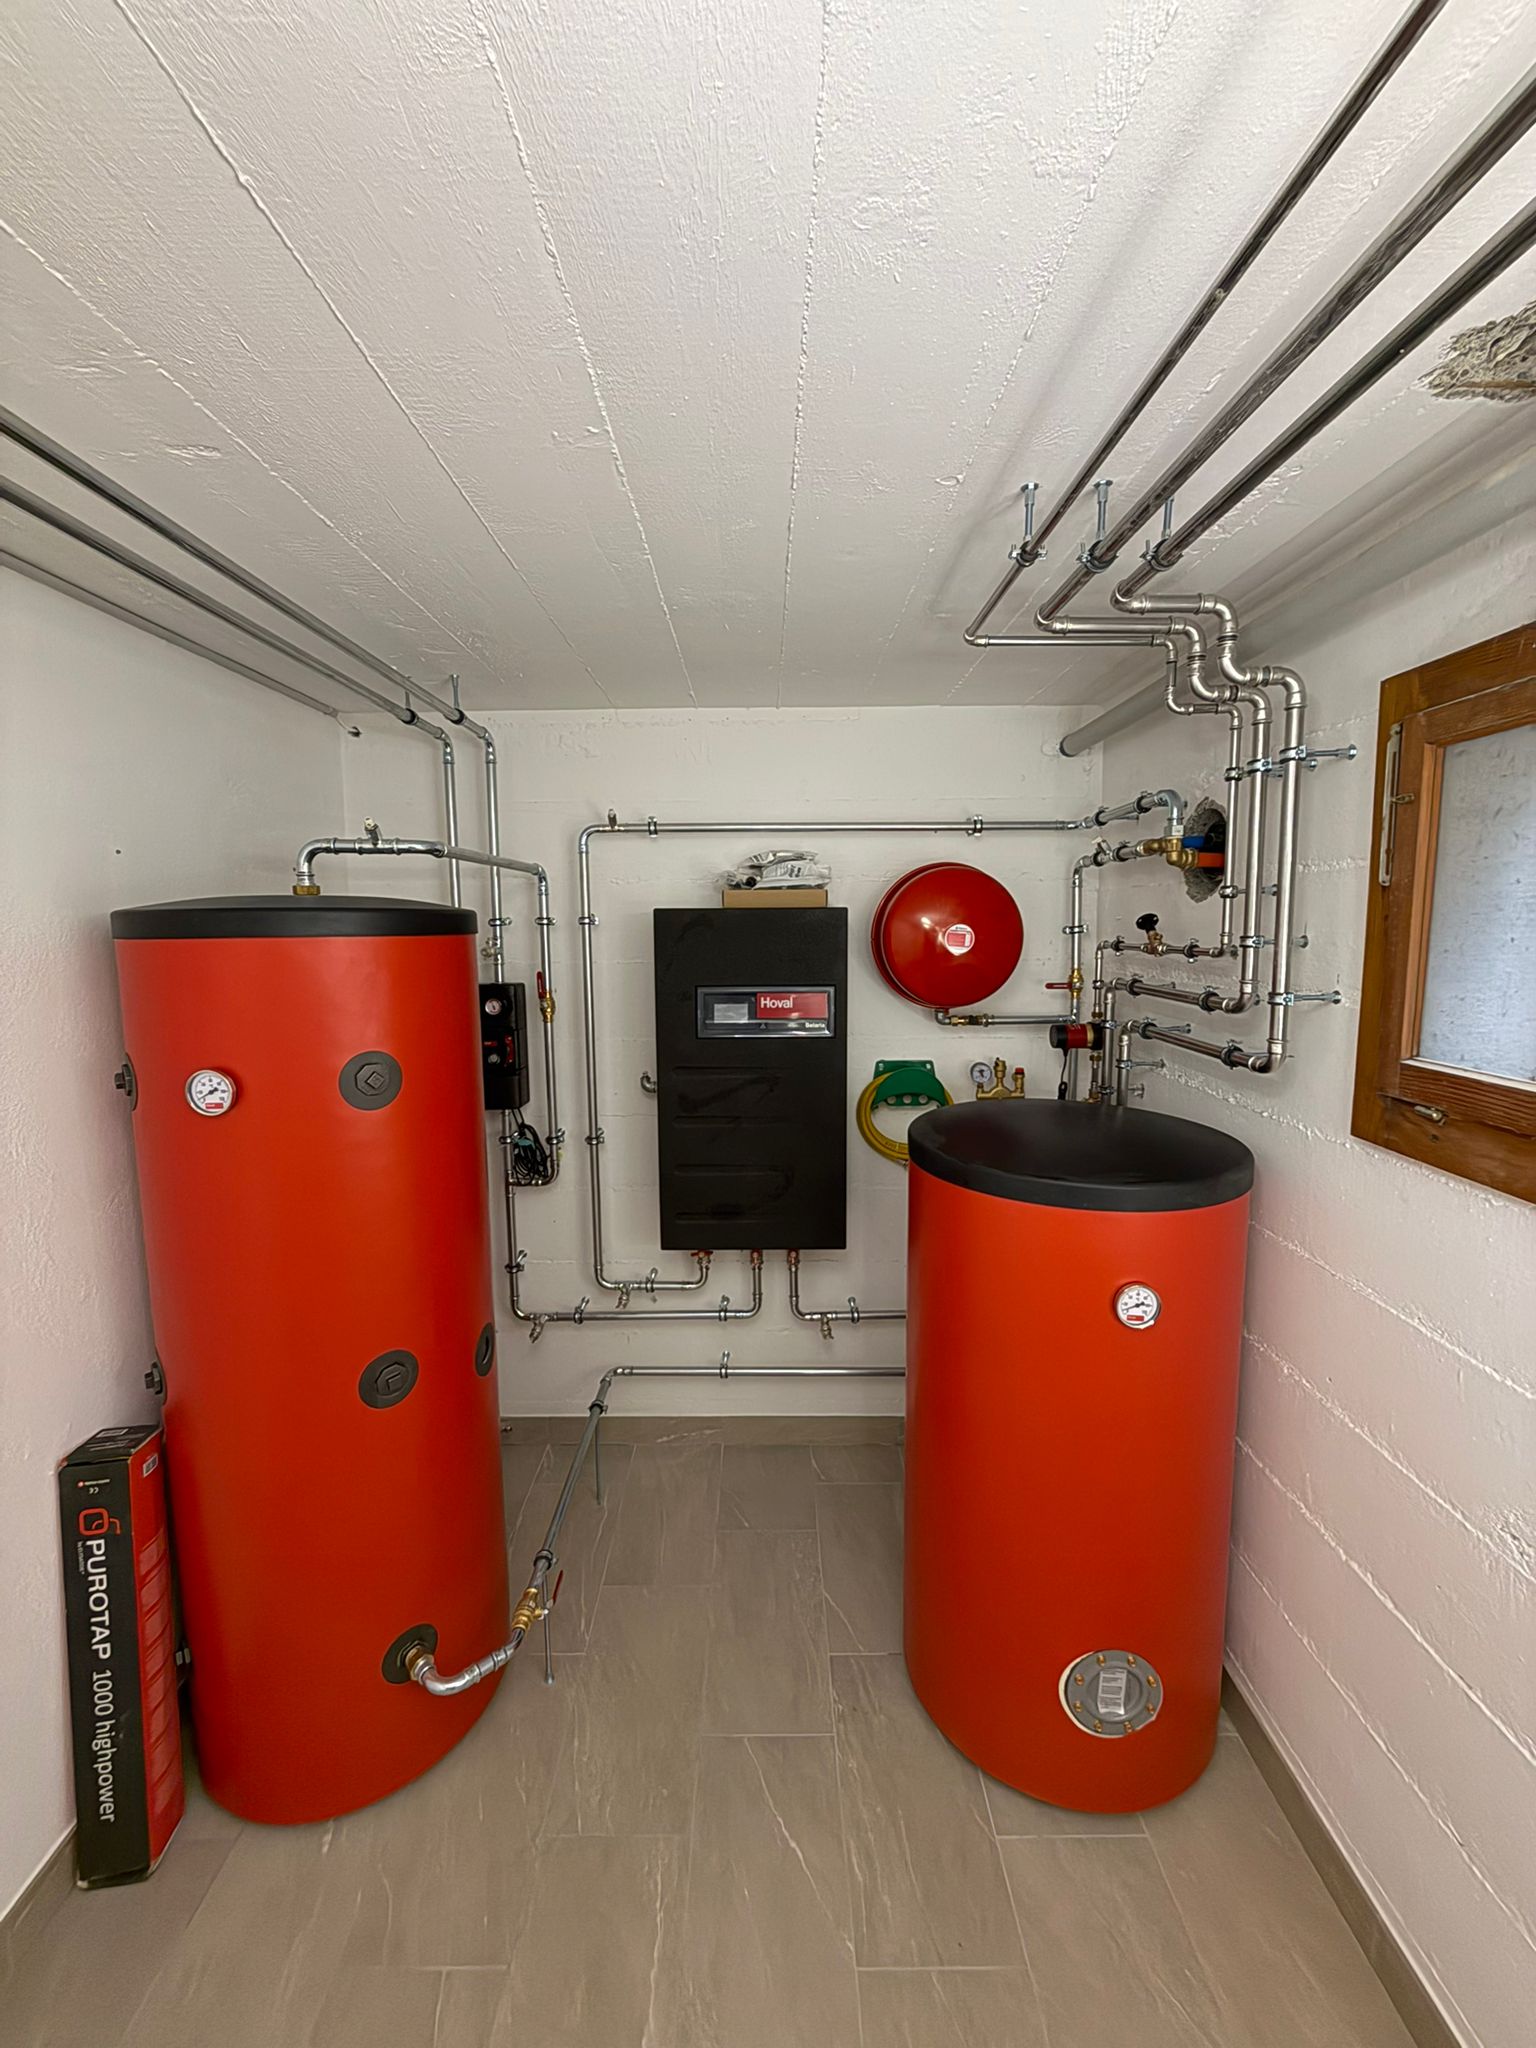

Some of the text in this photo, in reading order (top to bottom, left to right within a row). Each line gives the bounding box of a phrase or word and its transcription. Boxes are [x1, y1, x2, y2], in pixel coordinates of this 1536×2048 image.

[760, 996, 793, 1009] Hoval
[86, 1538, 118, 1823] PUROTAP 1000 highpower
